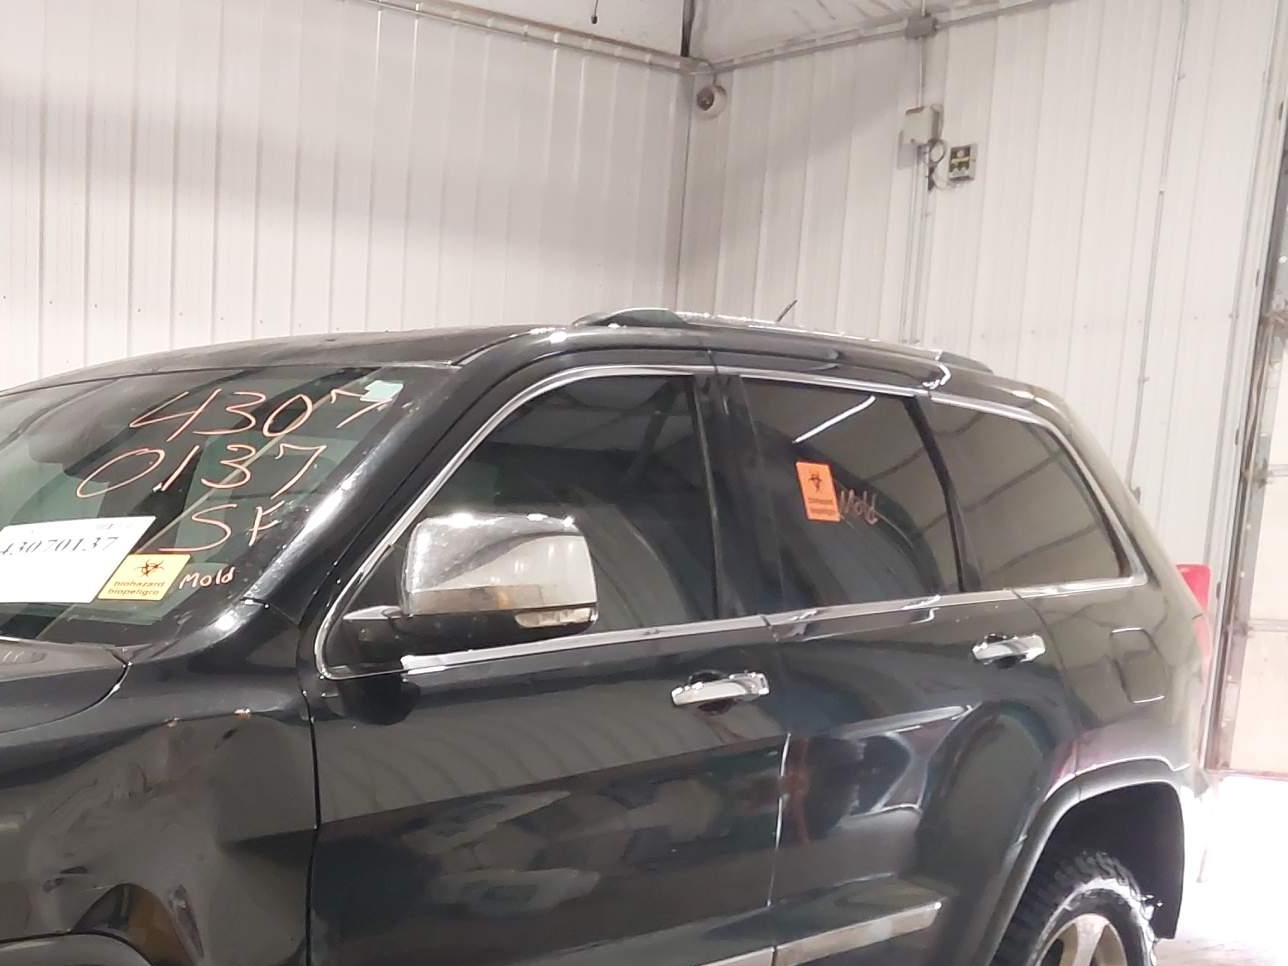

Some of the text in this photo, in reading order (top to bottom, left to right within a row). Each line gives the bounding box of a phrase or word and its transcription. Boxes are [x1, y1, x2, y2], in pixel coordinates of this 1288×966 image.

[128, 387, 394, 442] 4307
[75, 444, 328, 499] 0137
[178, 566, 236, 589] Mold
